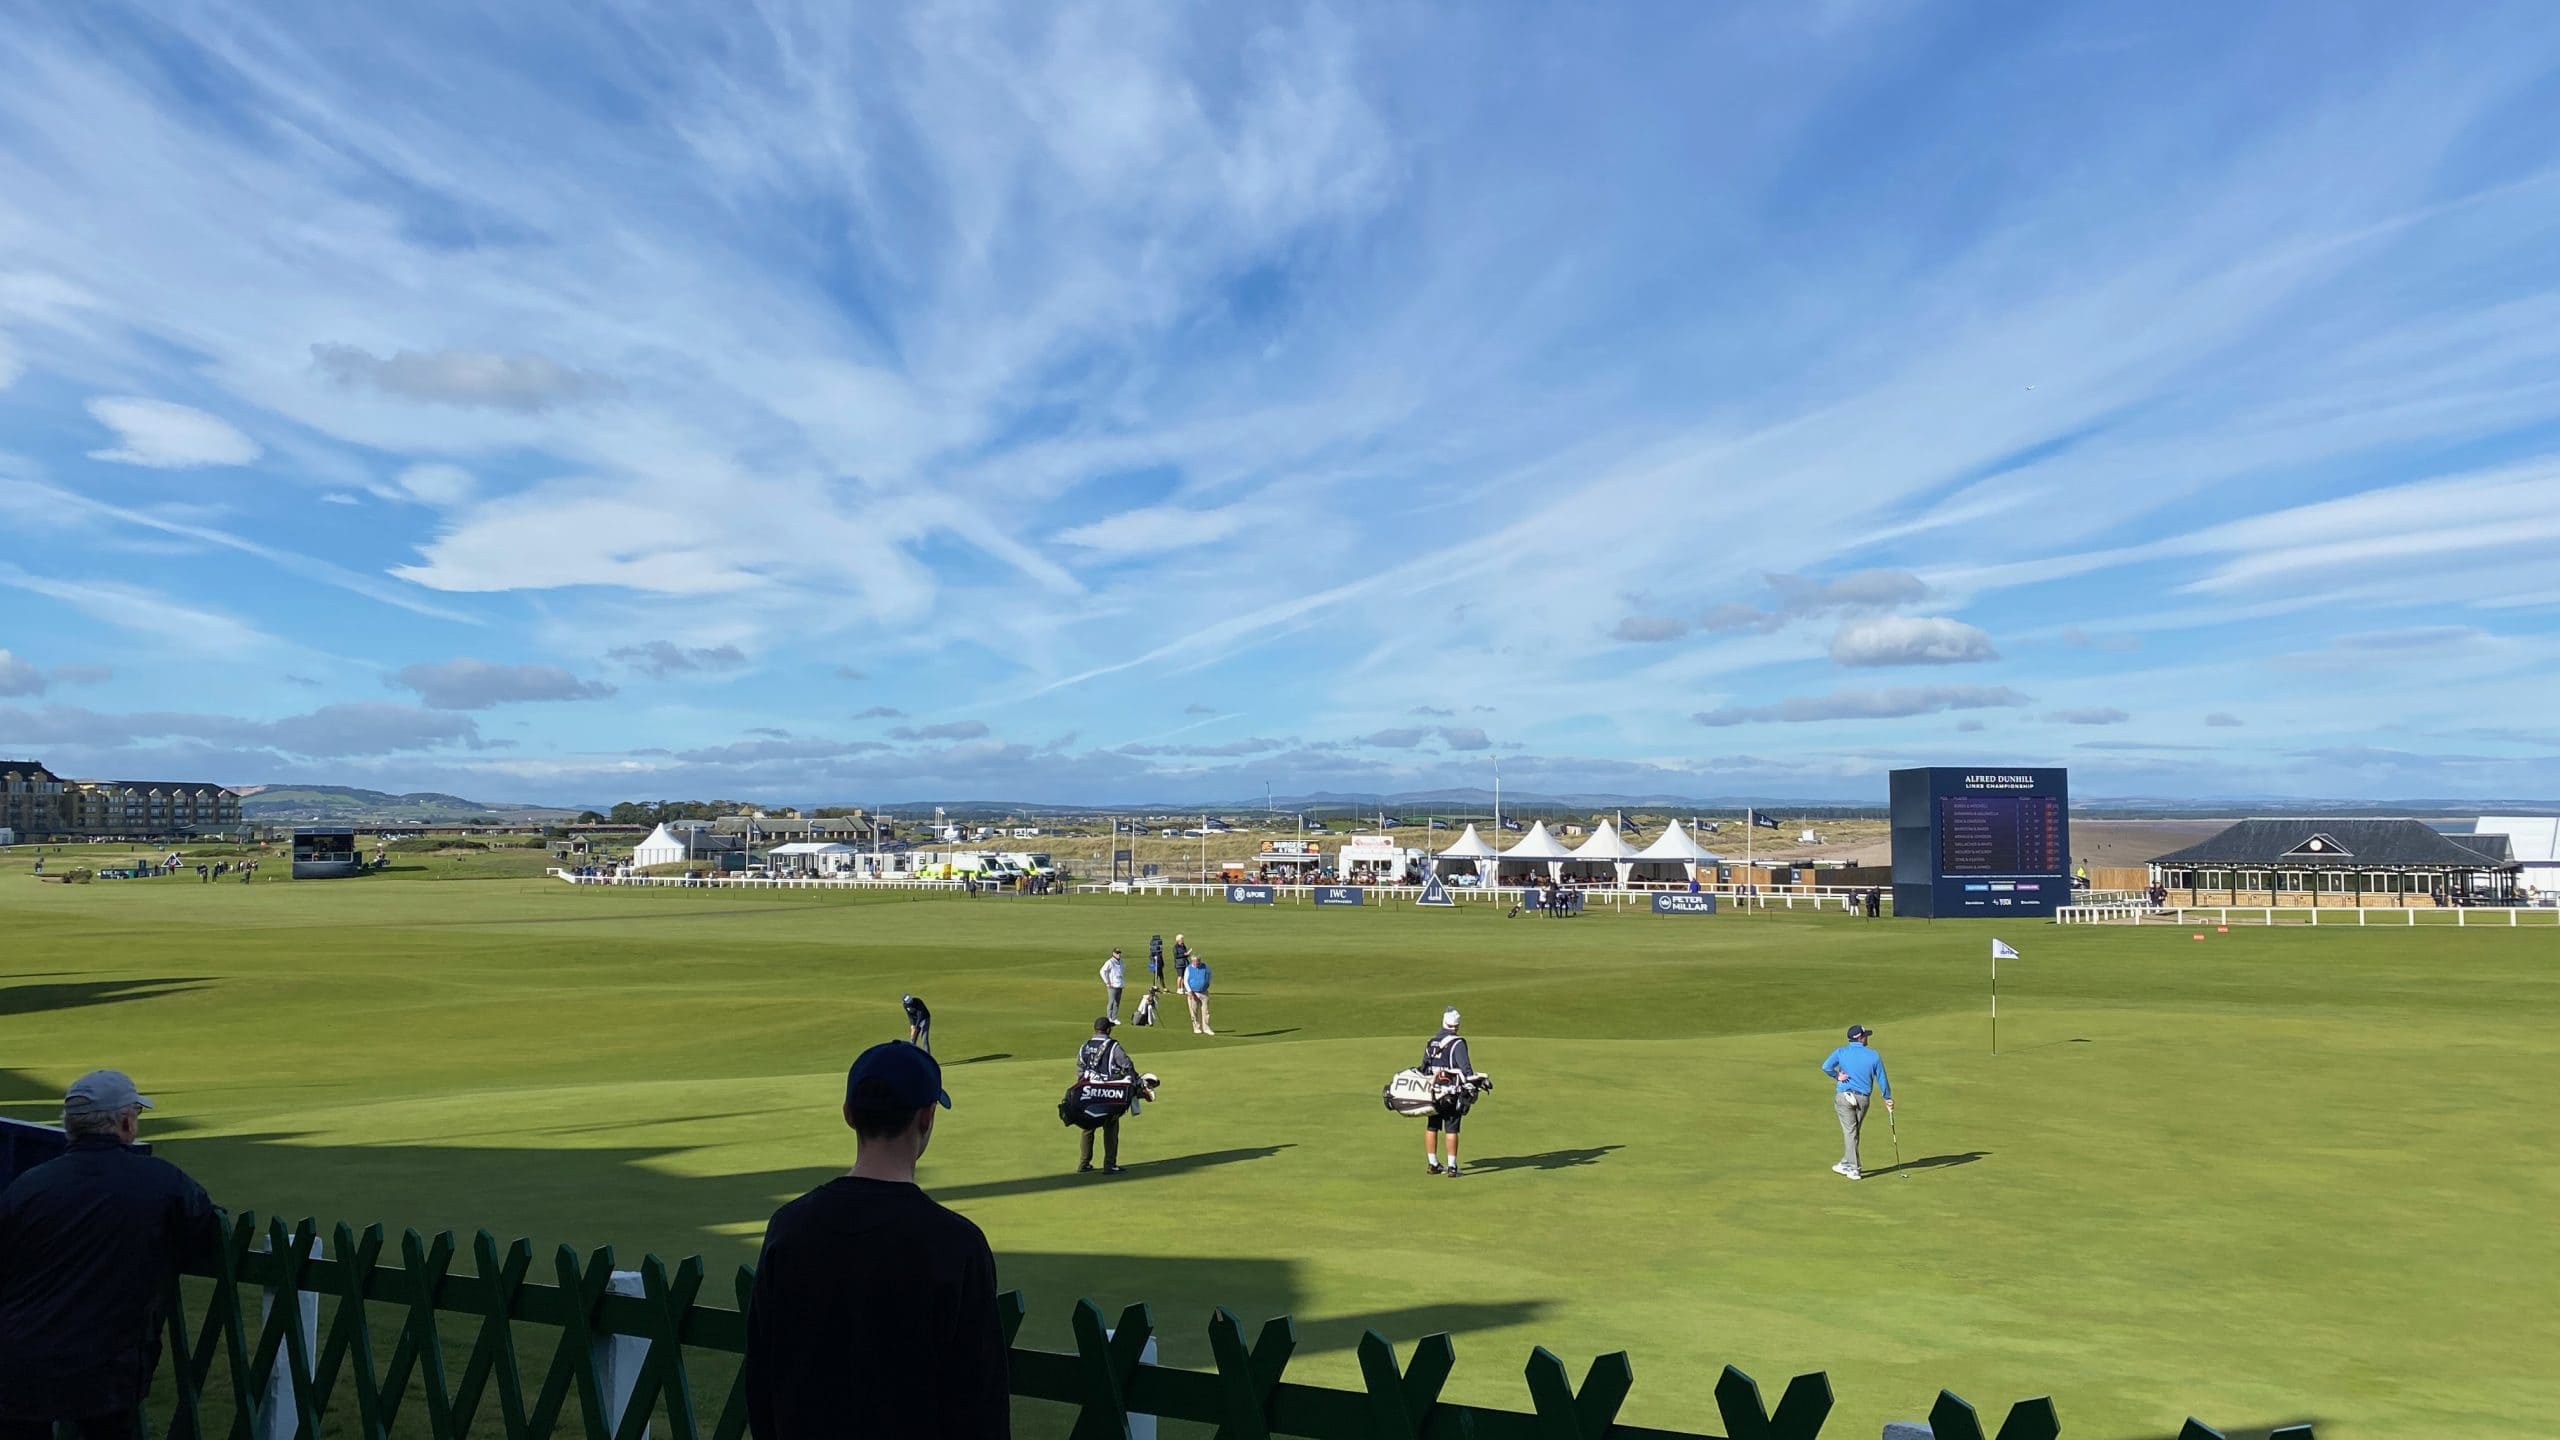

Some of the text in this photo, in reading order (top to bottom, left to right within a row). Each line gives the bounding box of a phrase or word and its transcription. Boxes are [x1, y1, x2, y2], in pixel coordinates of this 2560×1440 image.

[1965, 775, 2034, 783] ALFRED DUNHILL
[1329, 889, 1347, 899] IWC
[1672, 895, 1703, 904] PETER
[1672, 903, 1709, 912] MILLAR
[1081, 1085, 1125, 1100] SRIXON
